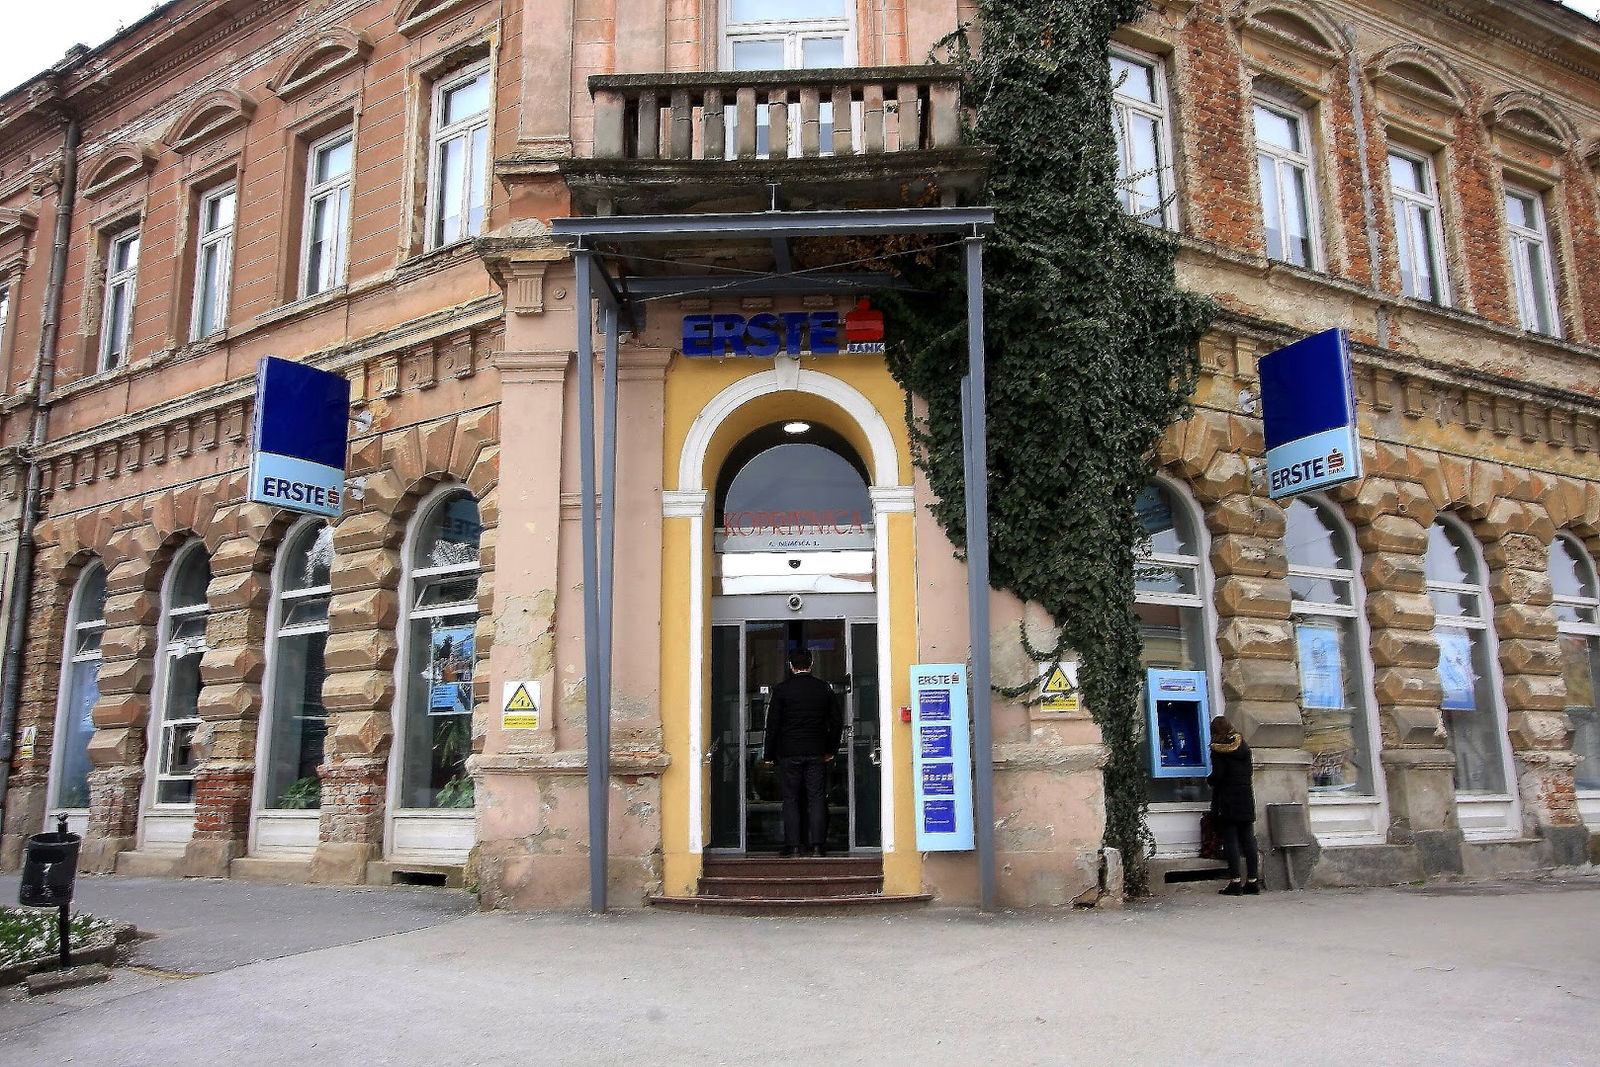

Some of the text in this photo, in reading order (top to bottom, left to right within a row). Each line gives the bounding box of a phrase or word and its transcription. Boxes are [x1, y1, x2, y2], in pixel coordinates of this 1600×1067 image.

[682, 312, 839, 357] ERSTE
[849, 343, 884, 353] BANK
[1271, 457, 1325, 490] ERSTE
[263, 477, 325, 506] ERSTE
[724, 510, 865, 537] KOPRIVNICA
[918, 675, 951, 685] ERSTE
